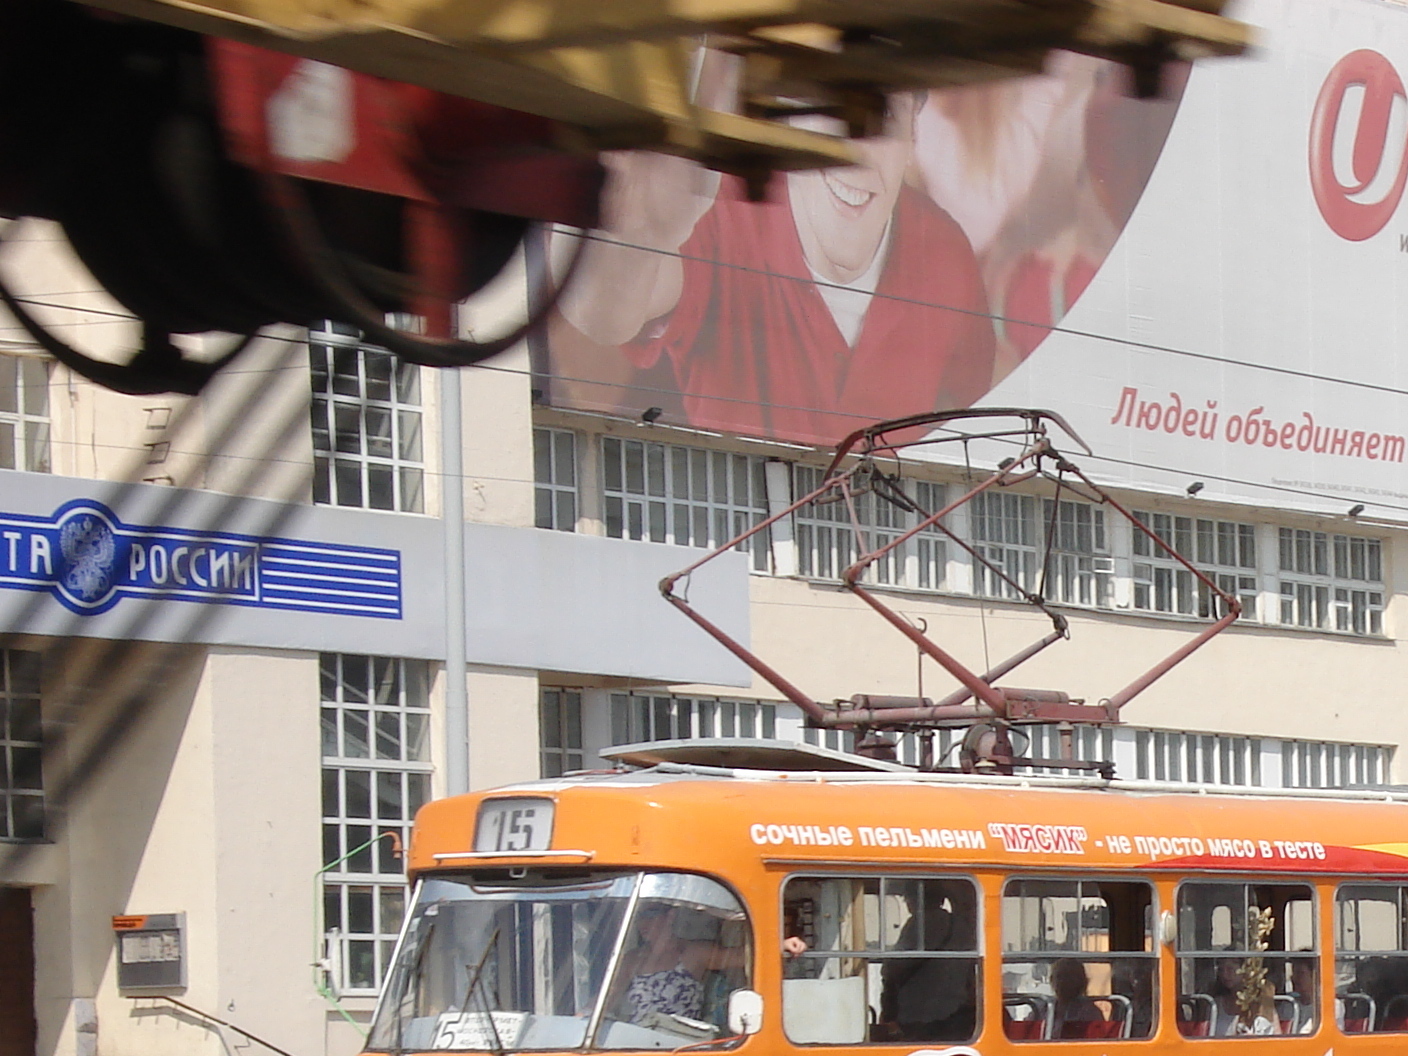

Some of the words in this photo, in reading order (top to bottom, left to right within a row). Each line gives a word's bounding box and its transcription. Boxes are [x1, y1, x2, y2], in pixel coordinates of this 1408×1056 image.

[1111, 386, 1217, 440] Людей
[1224, 405, 1406, 463] объединяет
[128, 543, 251, 590] РОССИИ
[493, 808, 536, 851] 15
[751, 823, 853, 846] сочные
[857, 826, 986, 850] пельмени
[1106, 834, 1132, 854] не
[1134, 835, 1204, 860] просто
[1207, 838, 1256, 858] мясо
[1274, 839, 1326, 860] тесте
